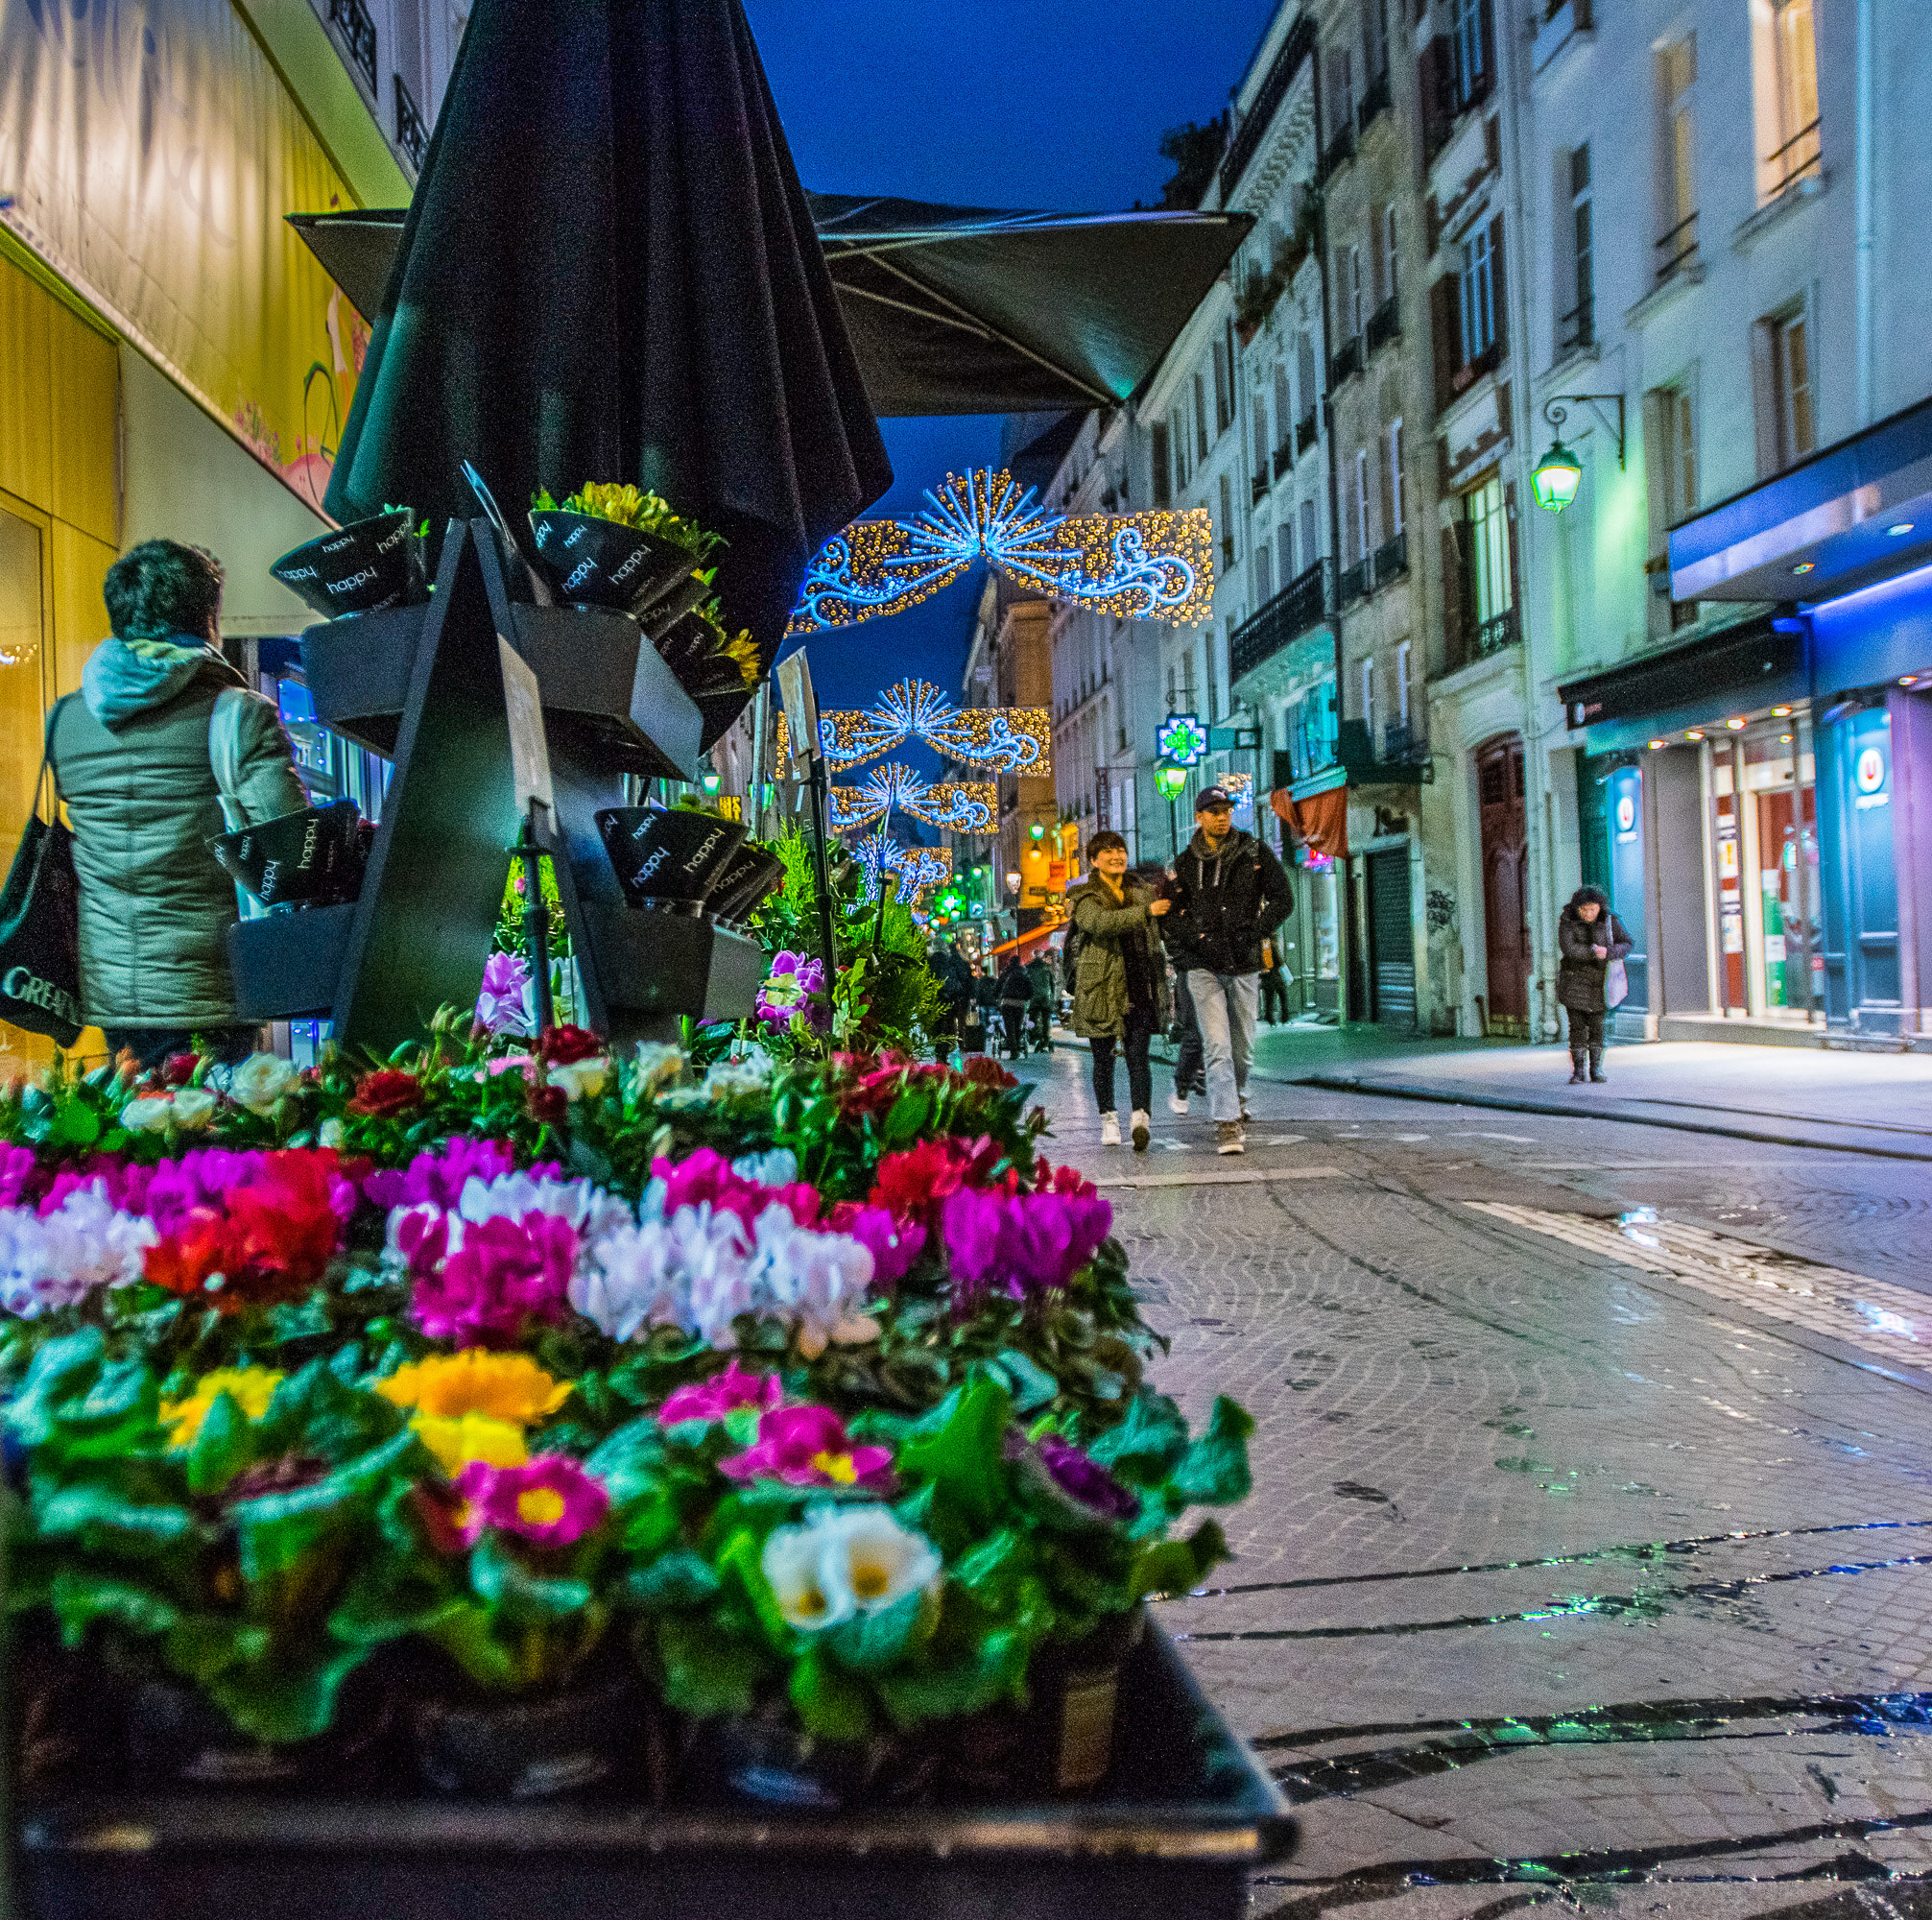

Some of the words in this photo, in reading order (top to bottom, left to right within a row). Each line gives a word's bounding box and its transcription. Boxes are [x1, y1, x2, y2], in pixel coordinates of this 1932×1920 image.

[322, 534, 355, 553] happy
[376, 520, 413, 554] happy
[562, 524, 587, 549] happy
[275, 565, 318, 582] happy
[325, 566, 378, 594] happy
[561, 556, 598, 594] happy
[608, 543, 652, 586] happy
[632, 813, 659, 840] happy
[239, 835, 252, 860] happy
[297, 818, 320, 870] happy
[682, 828, 727, 874] happy
[258, 859, 282, 901] happy
[630, 846, 671, 888] happy
[712, 860, 756, 894] happy
